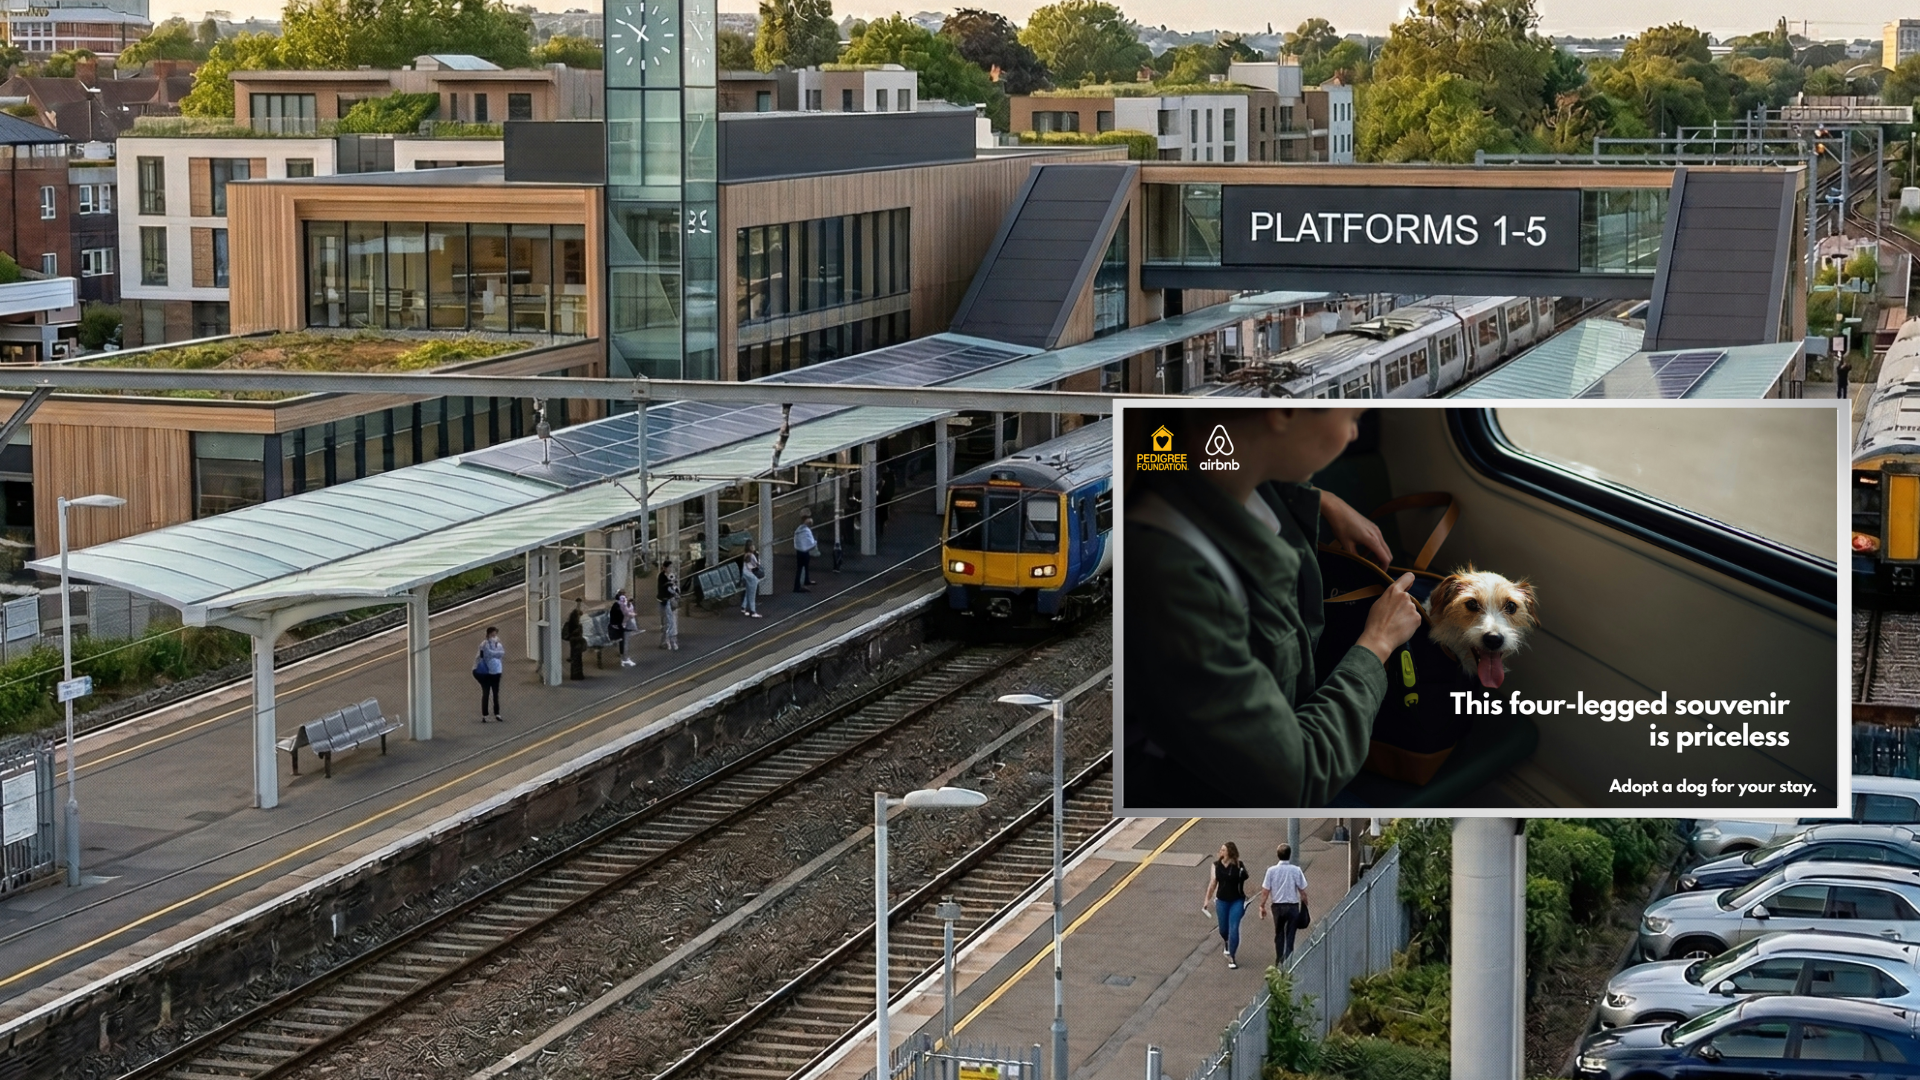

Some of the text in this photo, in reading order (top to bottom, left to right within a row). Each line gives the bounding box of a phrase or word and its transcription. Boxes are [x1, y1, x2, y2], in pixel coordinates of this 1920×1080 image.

[1250, 210, 1548, 248] PLATFORMS 1-5
[1136, 453, 1188, 463] PEDIGREE
[1199, 458, 1241, 471] airbnb
[1449, 690, 1791, 722] This four-legged souvenir
[1649, 723, 1790, 754] is priceless
[1608, 777, 1817, 797] Adopt a dog for your stay.
